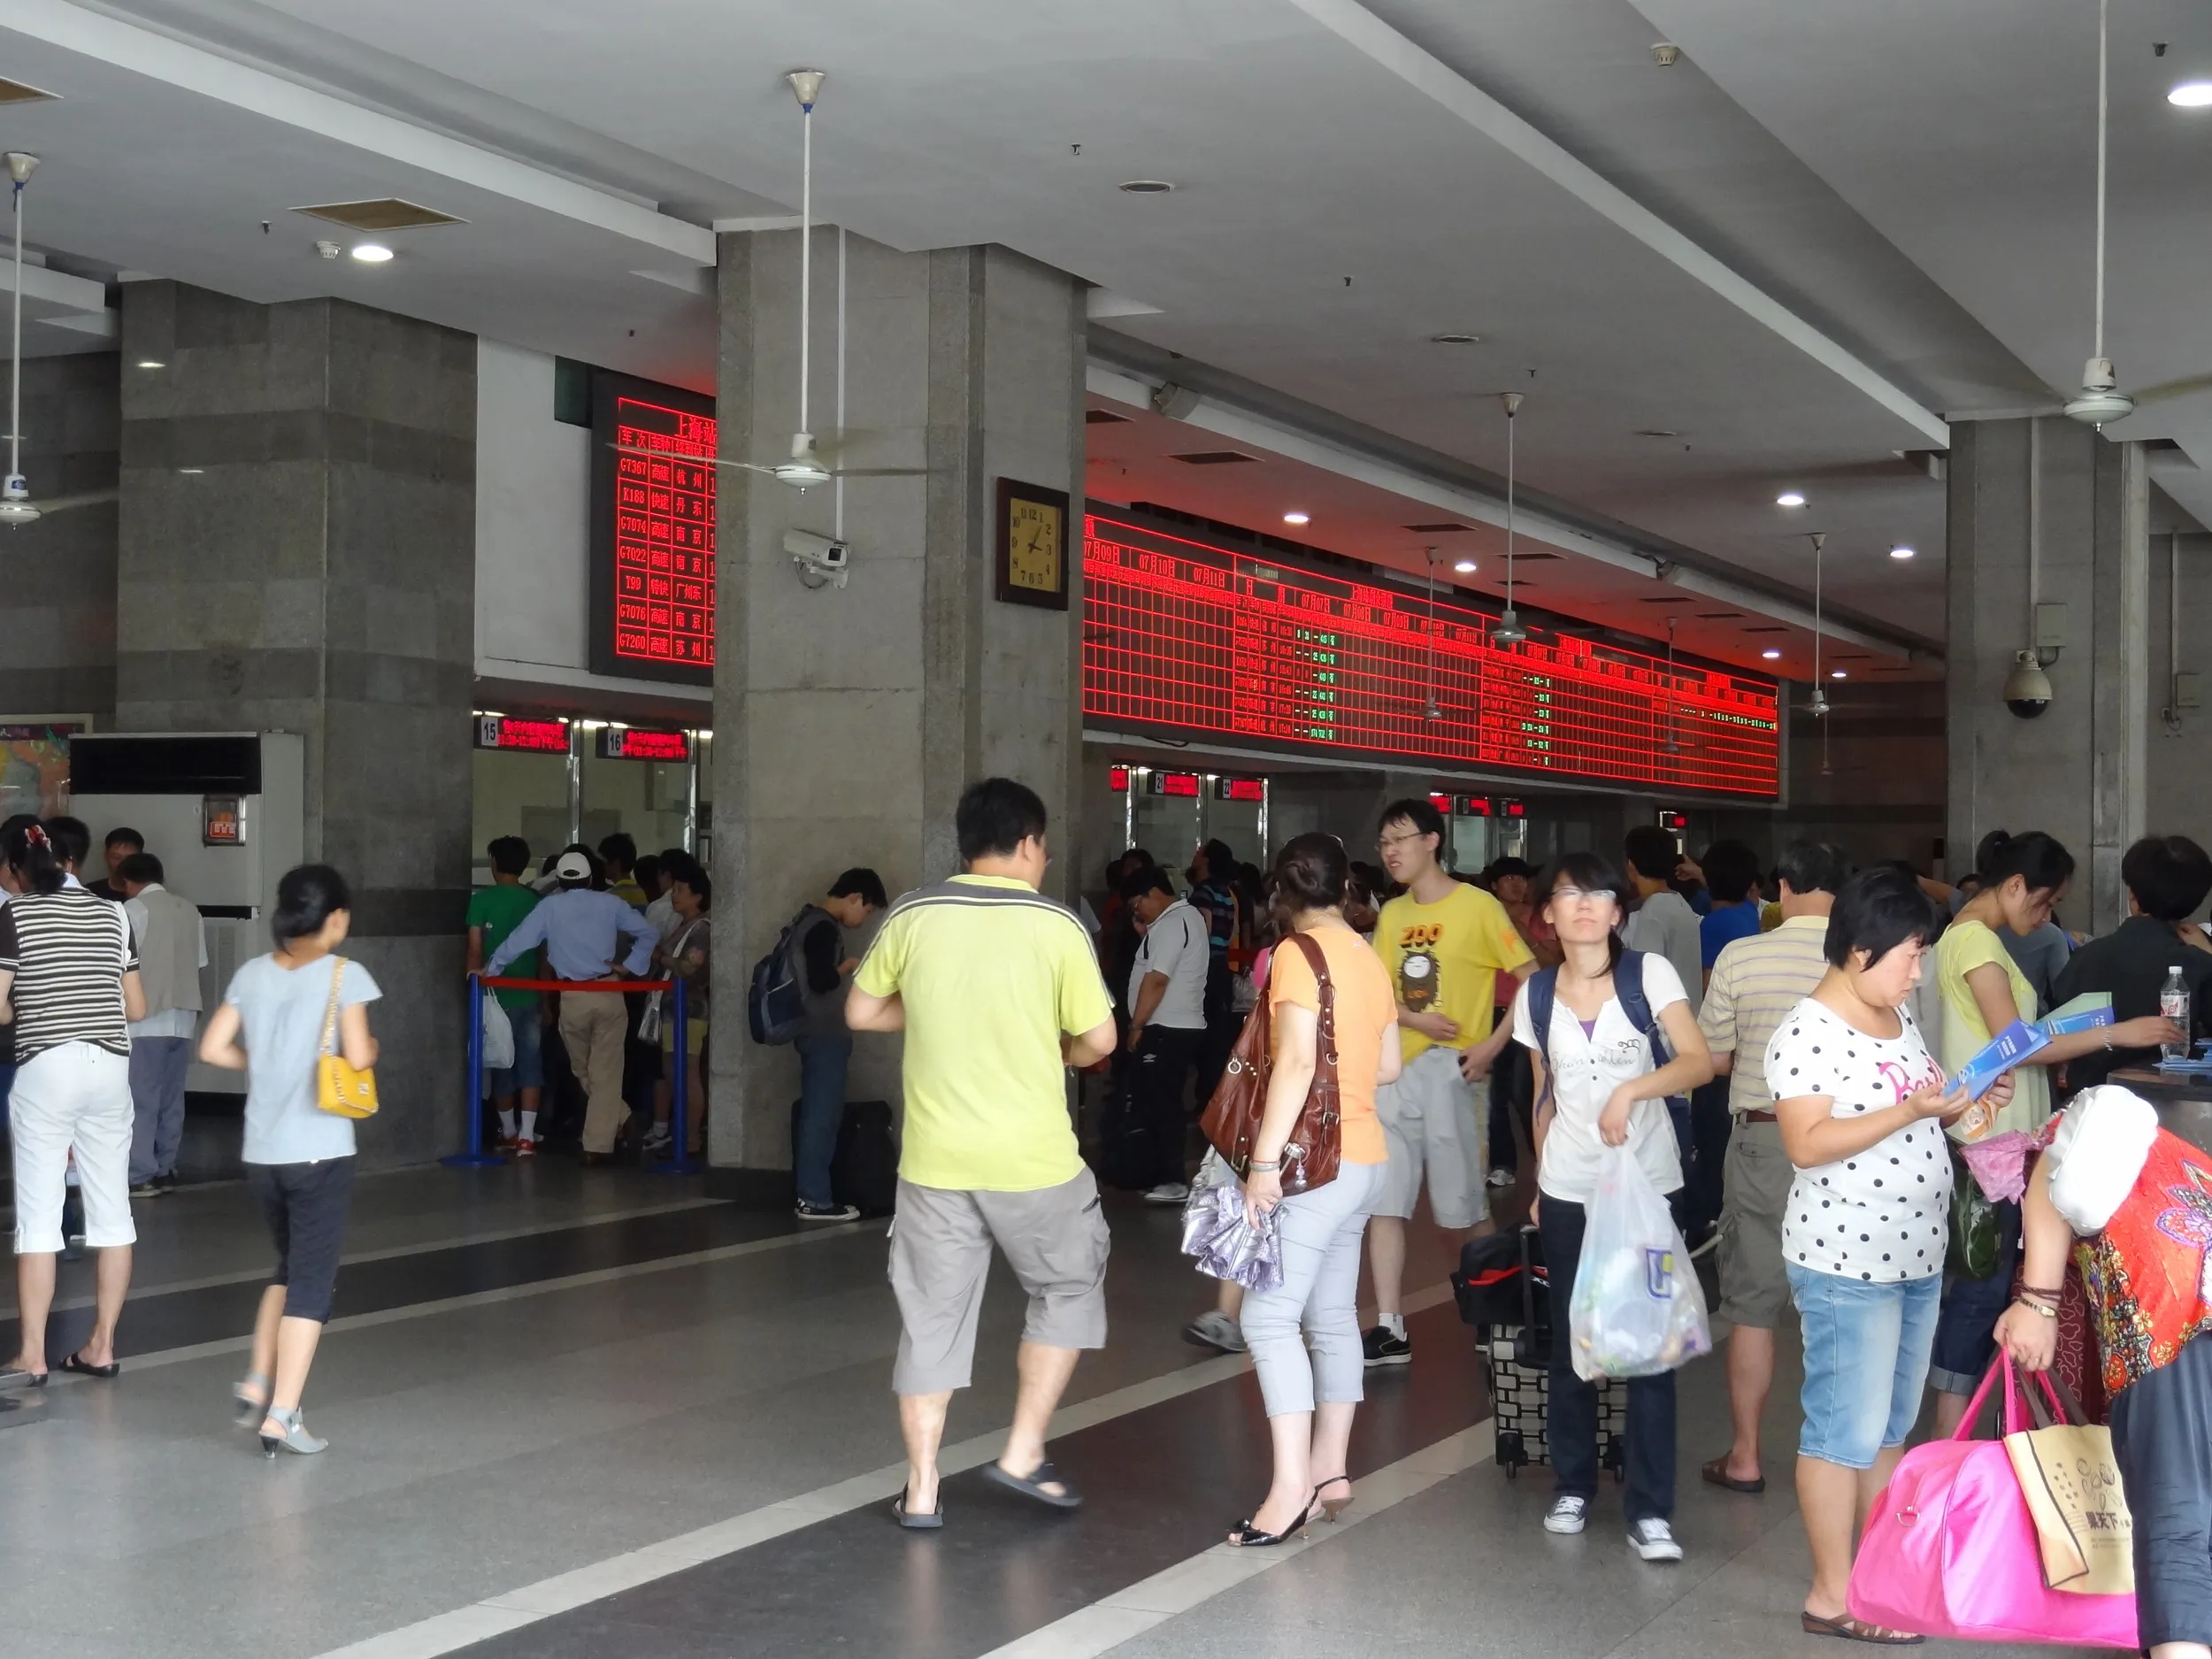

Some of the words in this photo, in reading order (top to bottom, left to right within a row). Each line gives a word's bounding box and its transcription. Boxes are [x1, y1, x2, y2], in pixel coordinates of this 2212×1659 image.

[1029, 508, 1037, 520] 12
[1039, 511, 1044, 524] 1
[1012, 517, 1020, 529] 10
[676, 526, 702, 545] 南京
[1046, 524, 1051, 535] 2
[1012, 536, 1018, 549] 9
[1046, 545, 1051, 556] 3
[620, 546, 646, 562] G7022
[676, 555, 702, 572] 南京
[1012, 558, 1018, 570] 8
[1020, 570, 1026, 582] 7
[1046, 565, 1049, 575] 4
[1140, 554, 1175, 578] 07月10日
[1194, 567, 1225, 588] 07月11日
[1028, 572, 1035, 584] 6
[1037, 573, 1043, 585] 5
[676, 583, 702, 600] 广州东
[676, 611, 701, 630] 南京
[483, 722, 495, 741] 15
[610, 733, 621, 751] 16
[1157, 777, 1163, 789] 21
[1224, 783, 1230, 795] 22
[1399, 924, 1444, 949] ZOO
